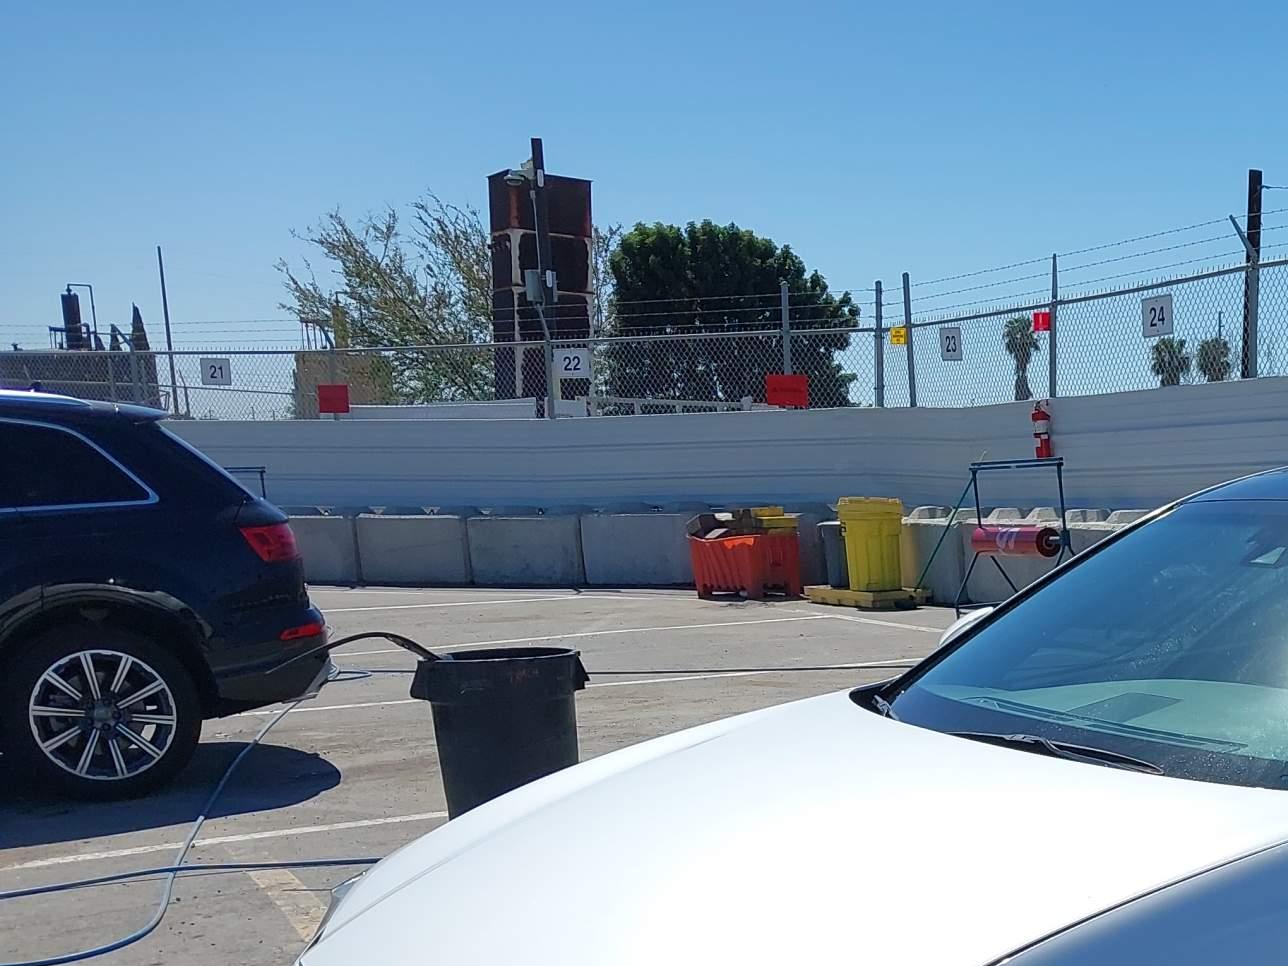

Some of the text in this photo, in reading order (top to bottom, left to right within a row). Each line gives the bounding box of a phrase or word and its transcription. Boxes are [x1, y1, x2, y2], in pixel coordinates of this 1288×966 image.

[1149, 306, 1165, 327] 24
[945, 335, 957, 353] 23
[563, 356, 581, 371] 22
[209, 365, 223, 379] 21
